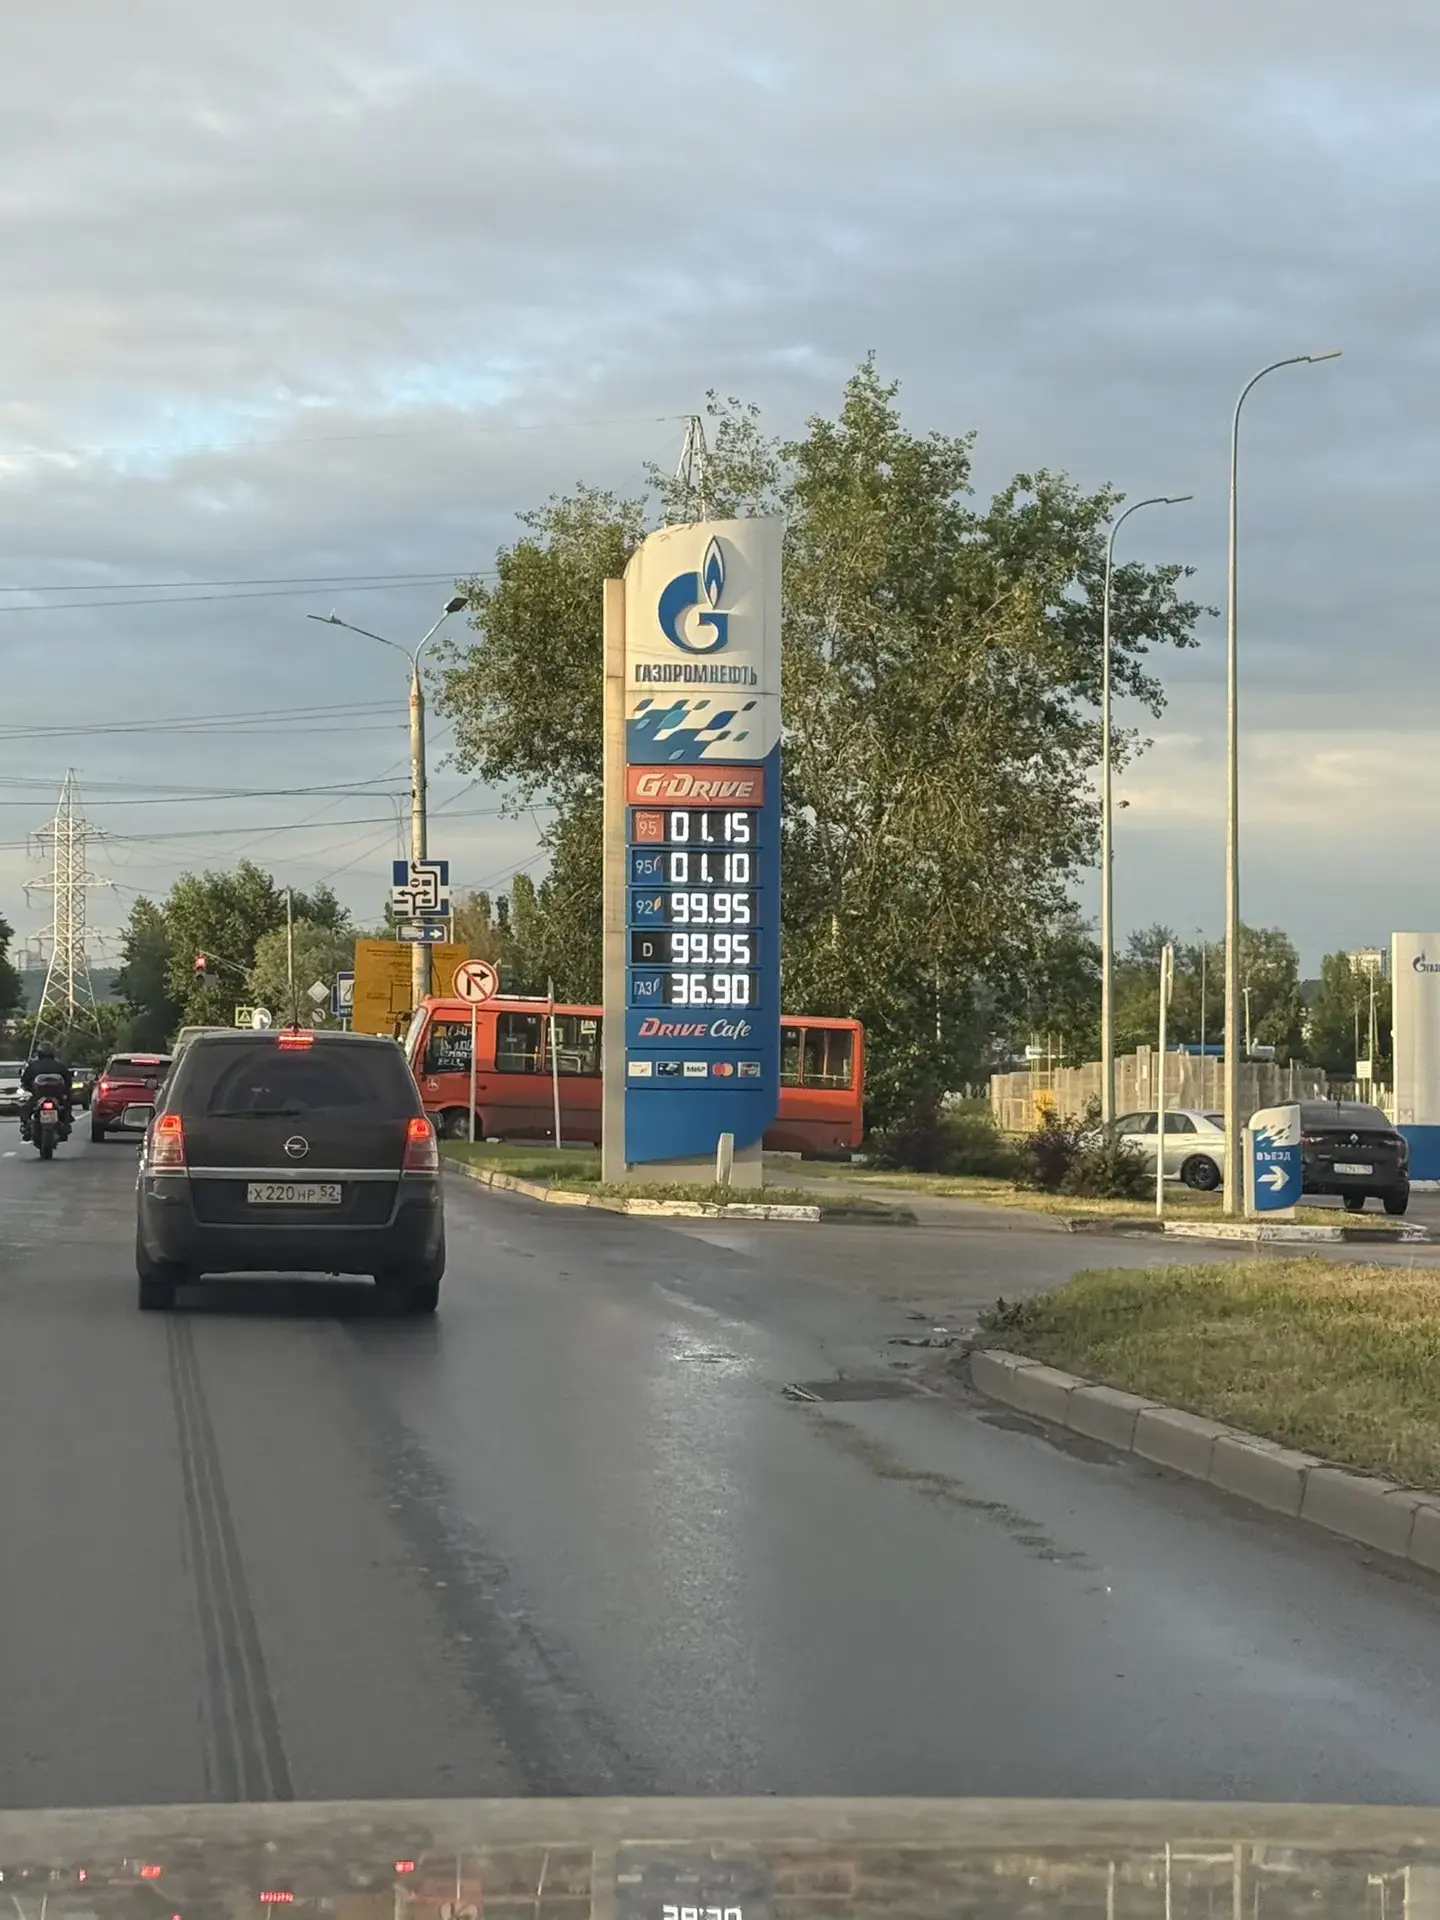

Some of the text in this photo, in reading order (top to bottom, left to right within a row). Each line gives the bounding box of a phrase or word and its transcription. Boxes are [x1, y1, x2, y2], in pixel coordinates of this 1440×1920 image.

[635, 664, 758, 686] ГАЗПРОМНЕФТЬ
[639, 821, 657, 836] 95
[671, 811, 750, 843] 01.15
[635, 852, 750, 883] 95 01.10
[636, 892, 751, 924] 92 99.95
[642, 933, 751, 964] D 99.95
[634, 973, 750, 1005] ГАЗ 36.90
[1256, 1151, 1291, 1161] ВЪЕЗД
[320, 1185, 336, 1197] 52
